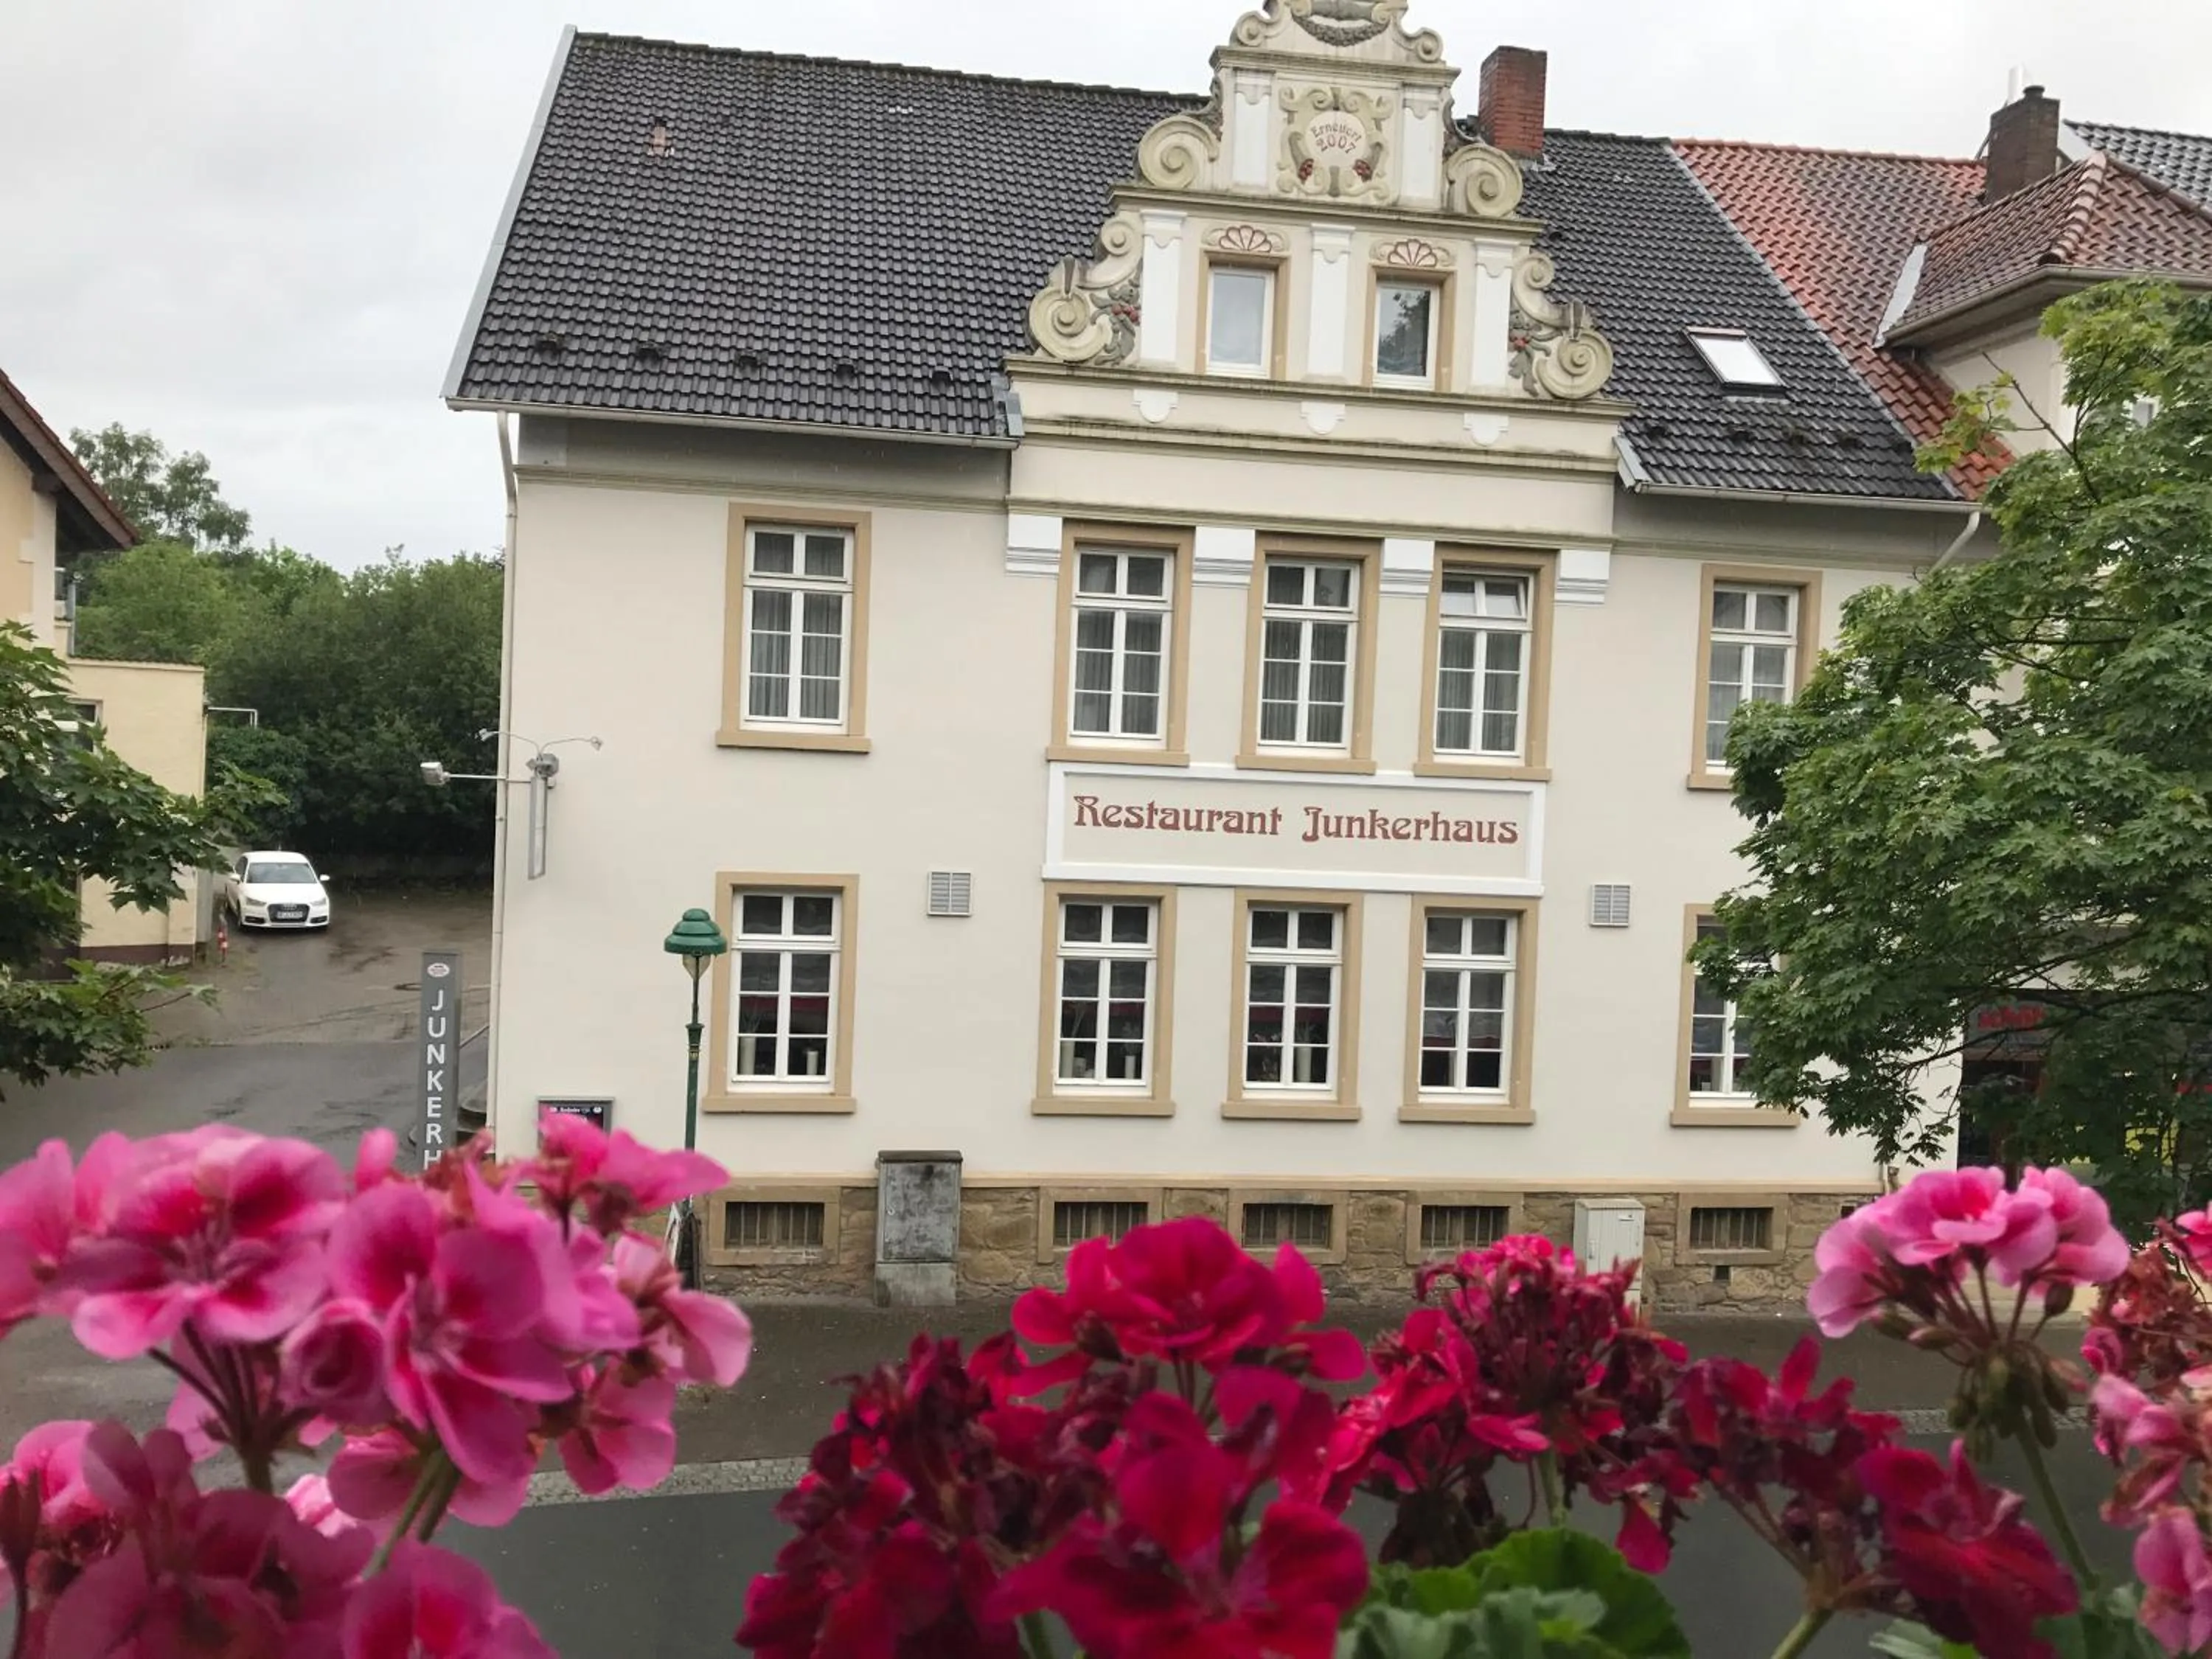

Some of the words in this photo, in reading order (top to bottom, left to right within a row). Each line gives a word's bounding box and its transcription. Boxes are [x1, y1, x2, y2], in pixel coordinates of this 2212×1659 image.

[1316, 134, 1356, 153] 2007
[1074, 796, 1282, 835] Restaurant
[1302, 807, 1519, 844] Junkerhaus
